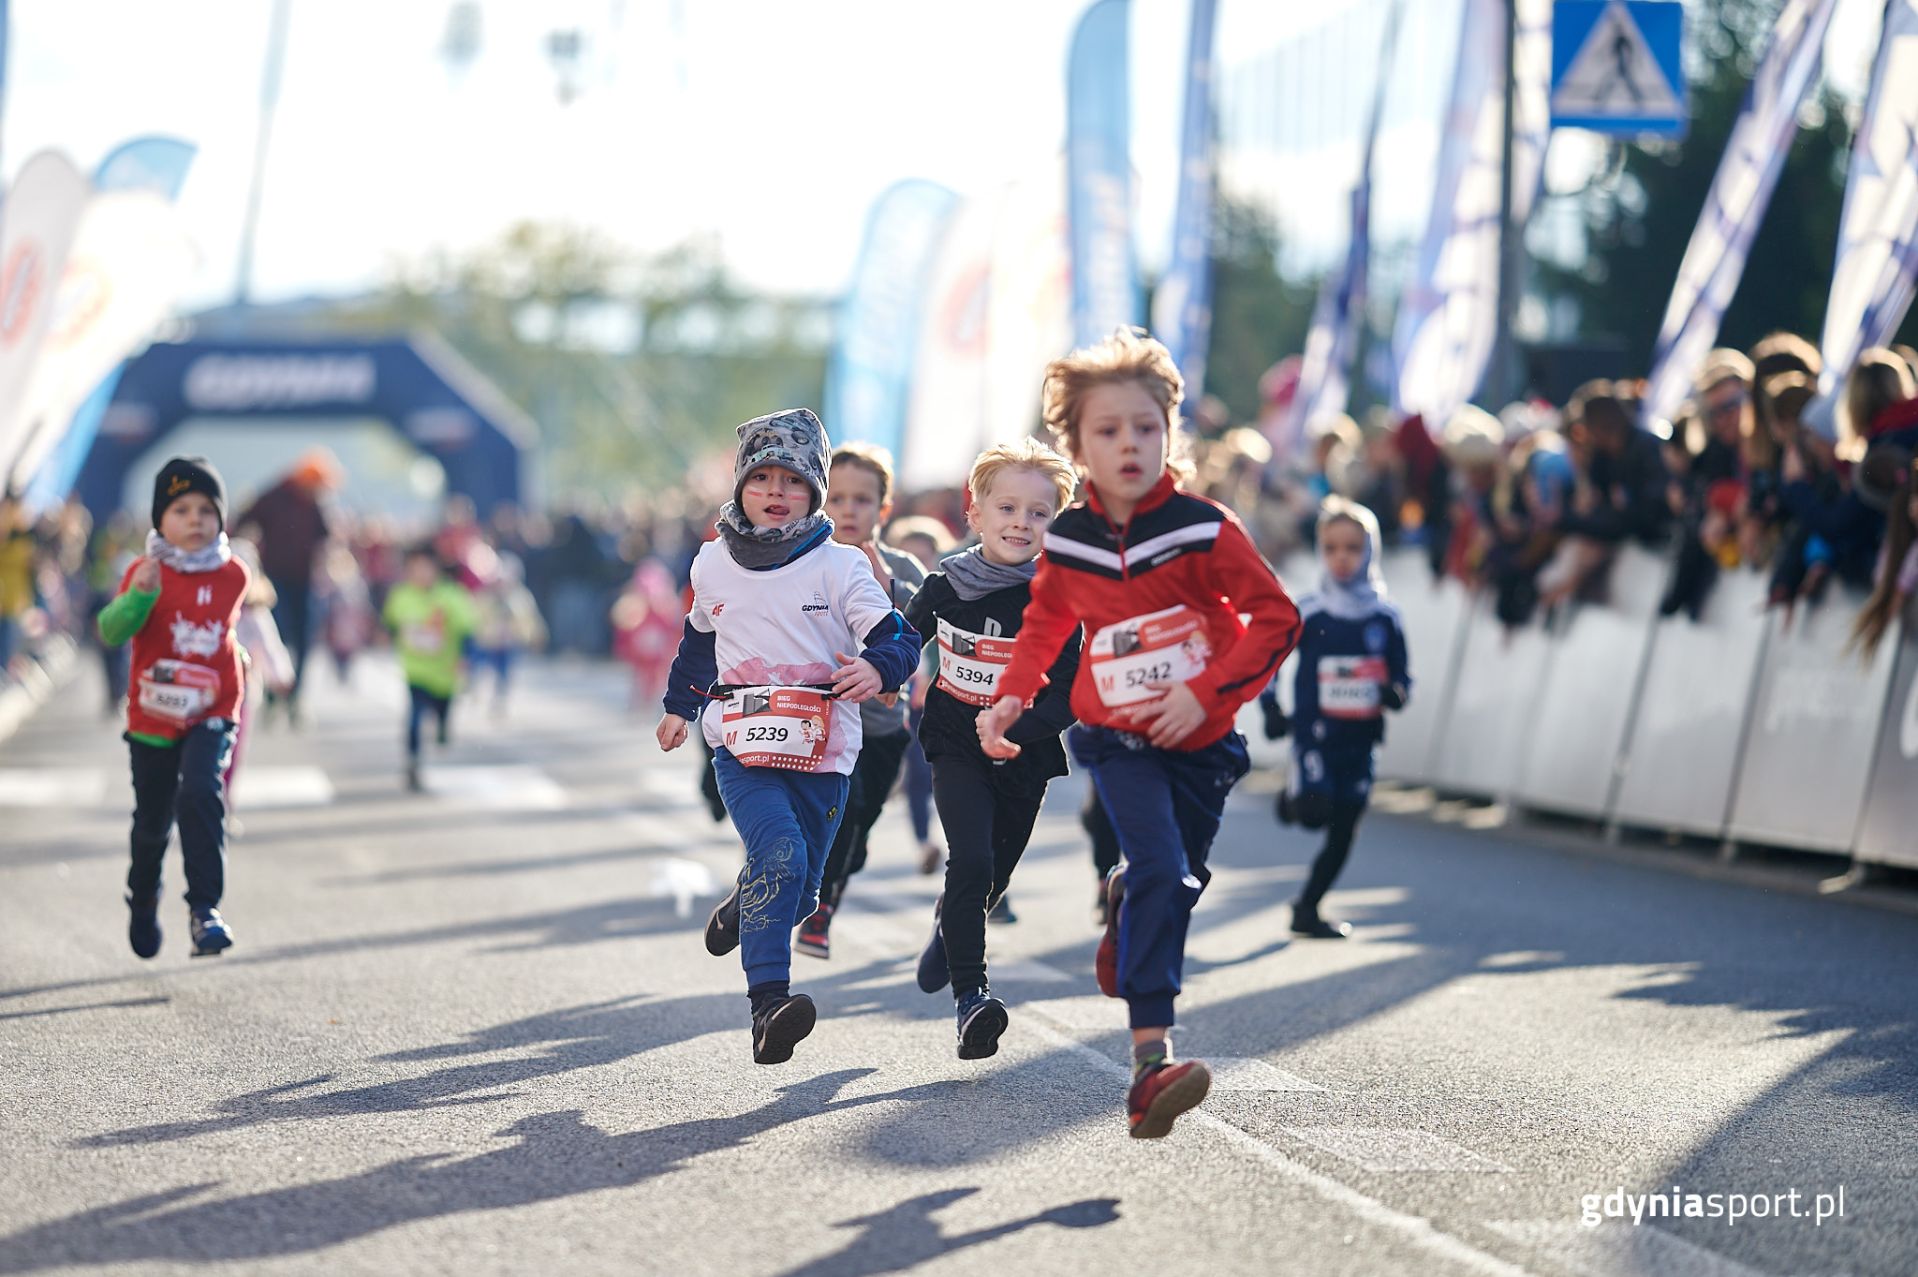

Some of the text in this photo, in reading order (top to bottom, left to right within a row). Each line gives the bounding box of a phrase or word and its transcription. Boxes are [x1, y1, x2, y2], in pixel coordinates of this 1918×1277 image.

[942, 656, 994, 686] M 5394
[1126, 661, 1172, 687] 5242
[726, 727, 788, 747] M 5239
